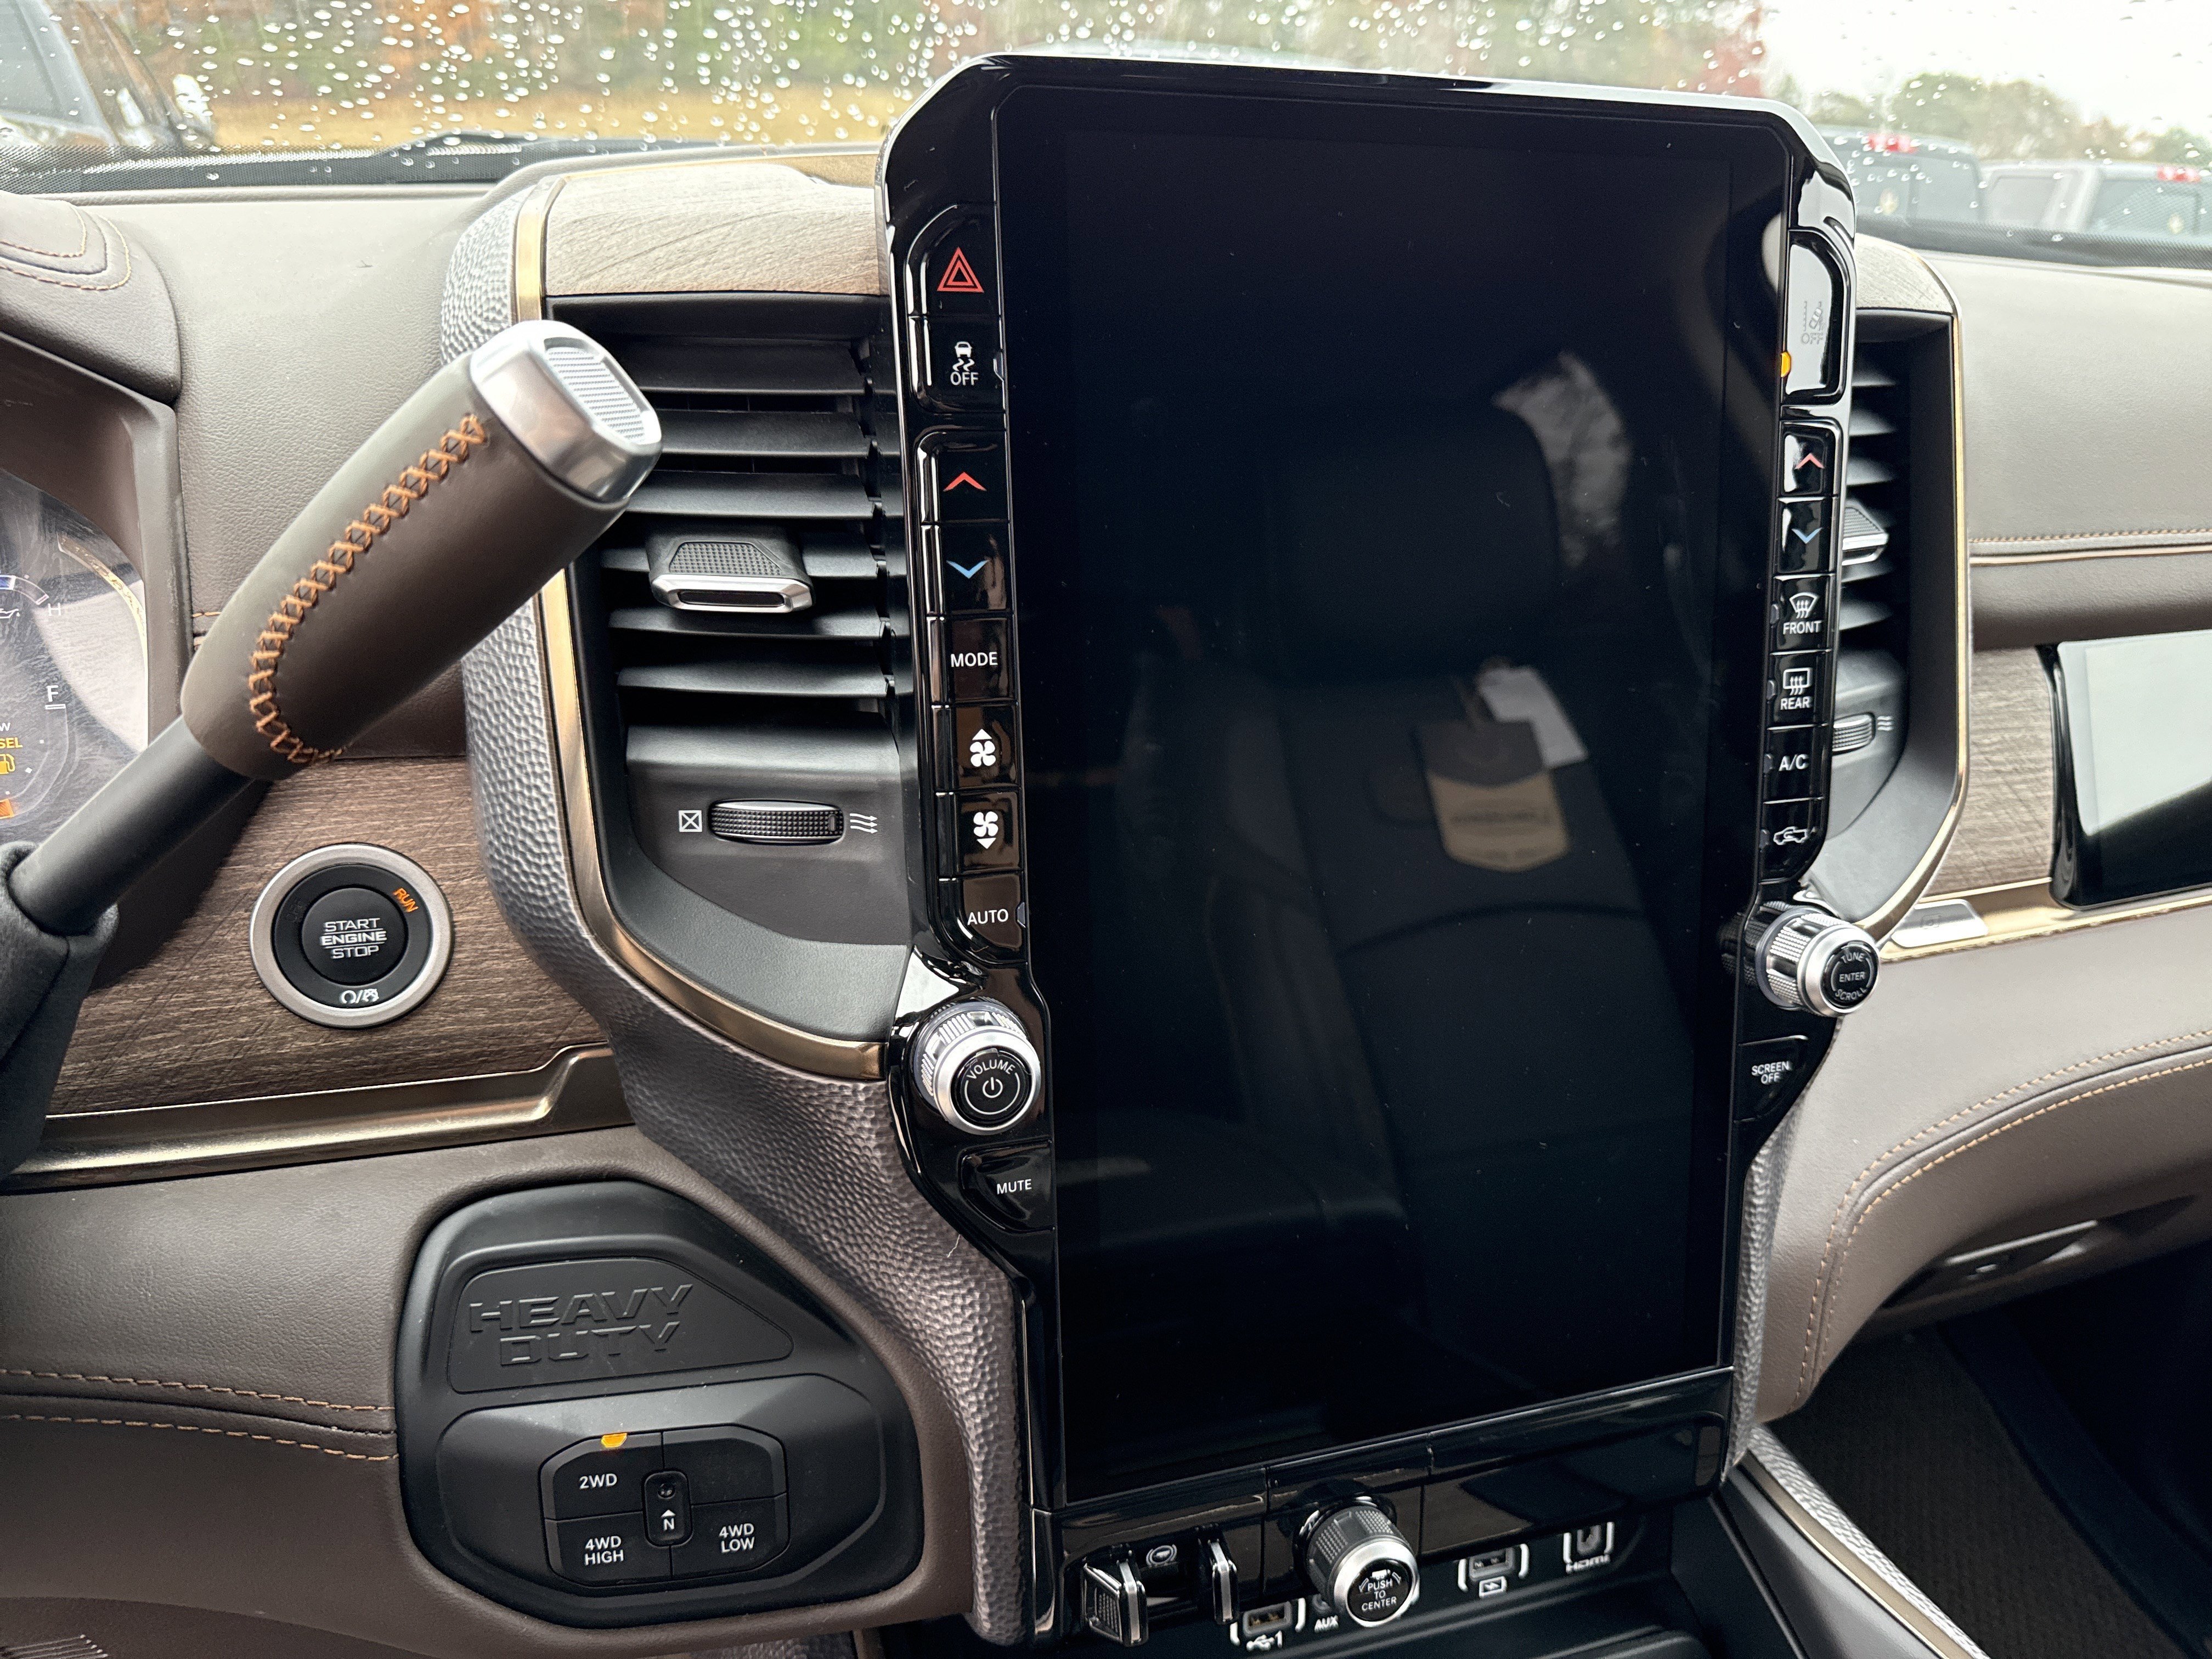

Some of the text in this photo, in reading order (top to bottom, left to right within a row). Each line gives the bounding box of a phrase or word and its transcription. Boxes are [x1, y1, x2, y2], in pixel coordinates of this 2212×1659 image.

[1801, 332, 1824, 345] OFF
[950, 371, 979, 386] OFF
[48, 602, 61, 616] H
[1783, 620, 1822, 635] FRONT
[950, 651, 998, 668] MODE
[47, 685, 59, 702] F
[1780, 696, 1811, 710] REAR
[1779, 753, 1809, 771] A/C
[393, 888, 419, 913] RUN
[324, 917, 381, 932] START
[967, 909, 1009, 926] AUTO
[321, 930, 387, 945] ENGINE
[331, 945, 380, 959] STOP
[1841, 952, 1865, 963] TUNE
[1839, 972, 1865, 983] ENTER
[1835, 988, 1867, 1000] SCROLL
[967, 1059, 1016, 1081] VOLUME
[1751, 1060, 1792, 1076] SCREEN
[1760, 1072, 1781, 1085] OFF
[996, 1178, 1032, 1195] MUTE
[469, 1284, 693, 1332] HEAVY
[500, 1321, 680, 1366] DUTY
[579, 1473, 618, 1489] 2WD
[663, 1517, 675, 1531] N
[719, 1522, 754, 1538] 4WD
[585, 1536, 622, 1551] 4WD
[720, 1537, 755, 1553] LOW
[584, 1550, 624, 1566] HIGH
[1367, 1578, 1393, 1592] PUSH
[1374, 1590, 1386, 1600] TO
[1361, 1596, 1397, 1612] CENTER
[1314, 1615, 1339, 1633] AUX
[1275, 1630, 1283, 1647] 1
